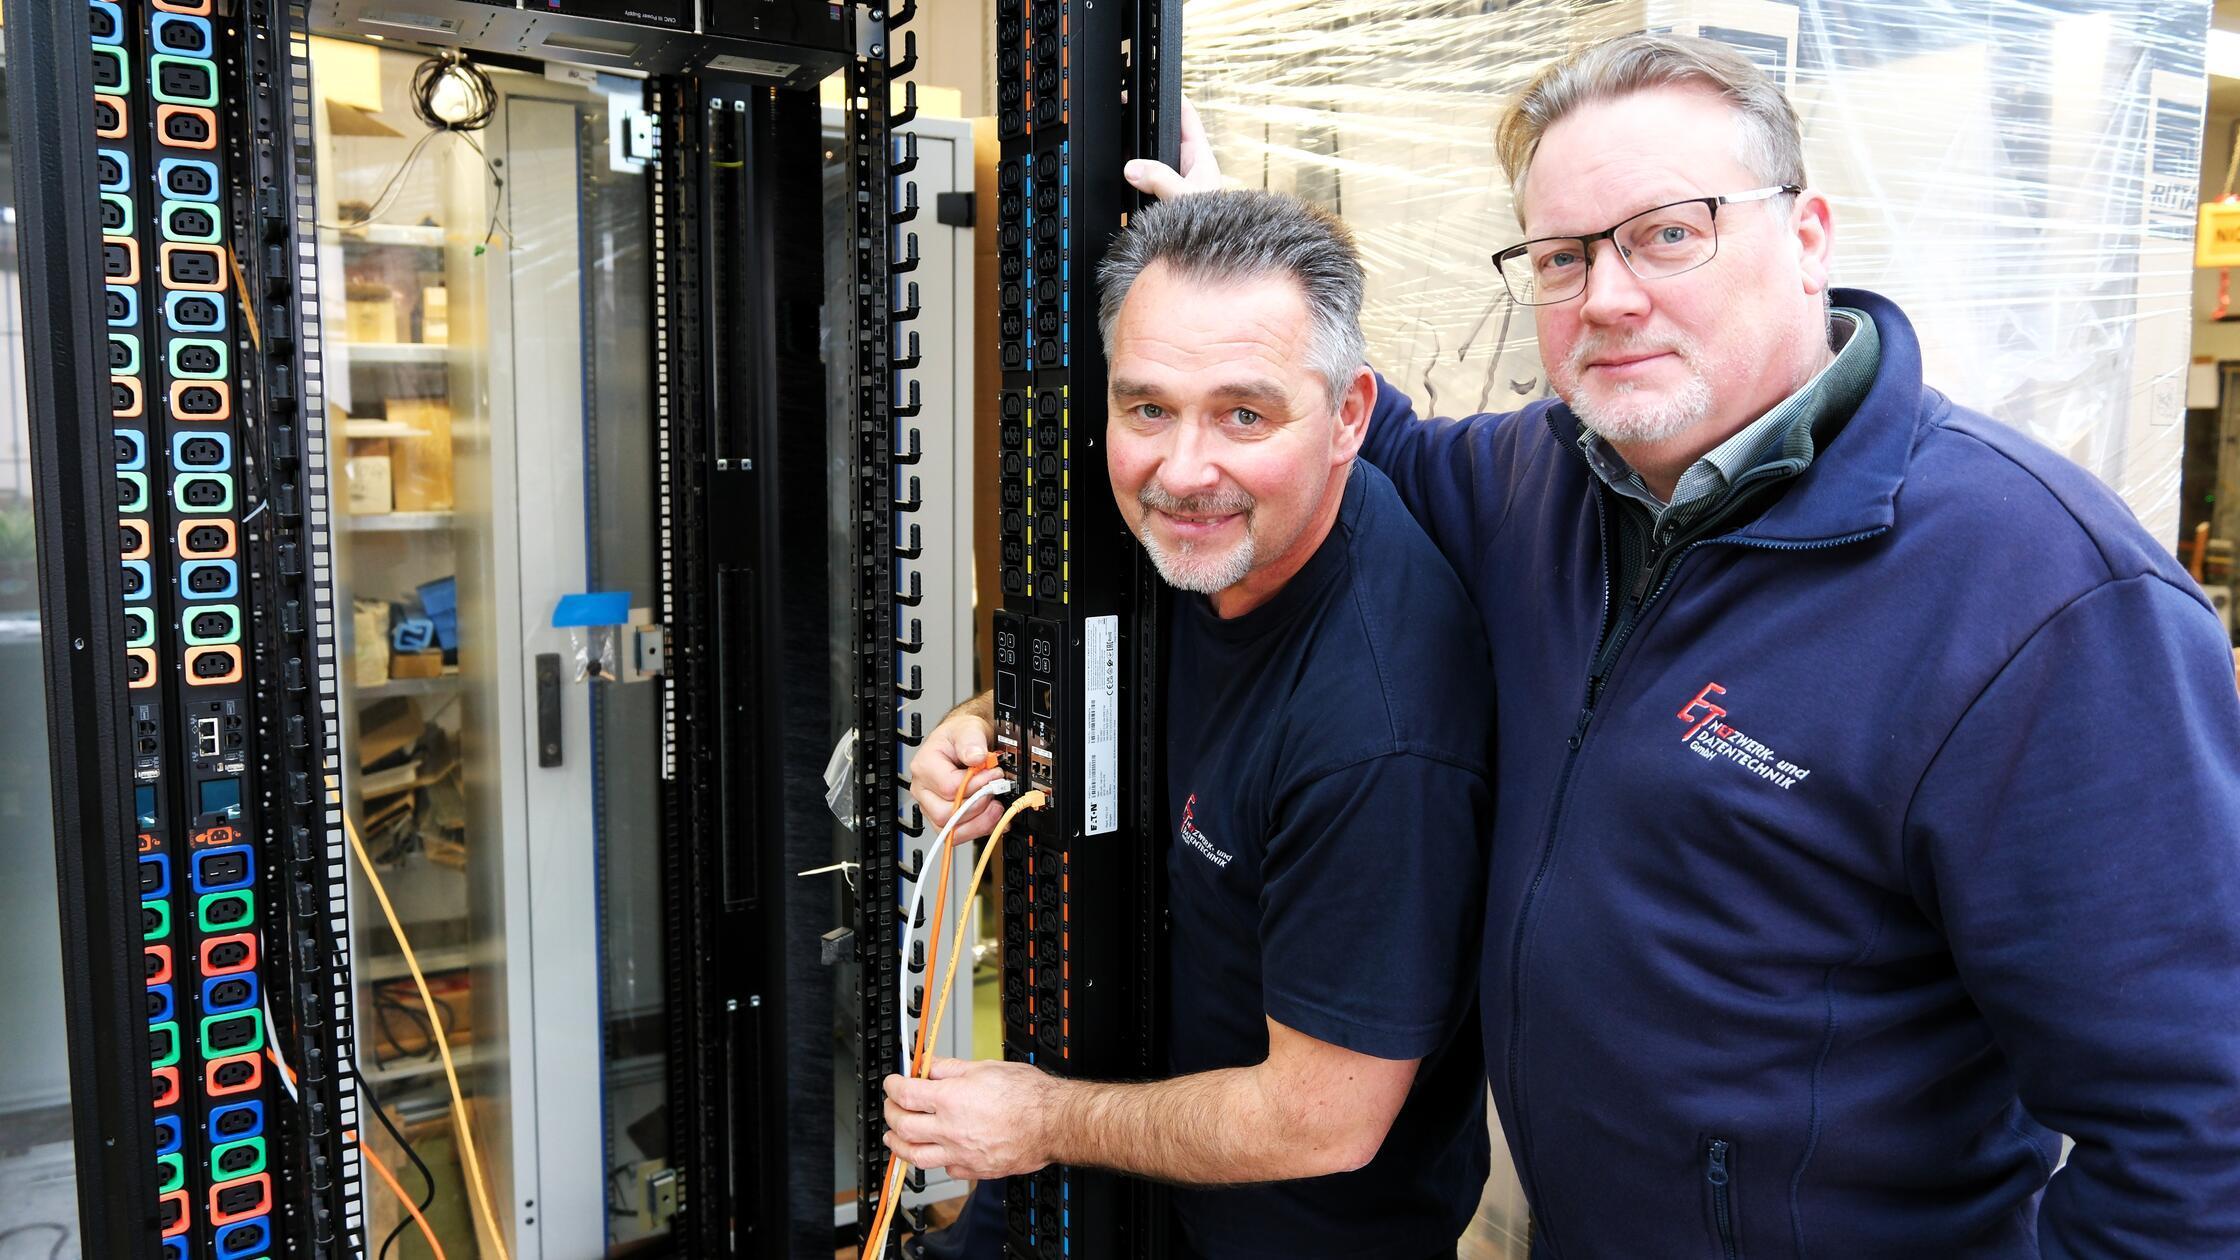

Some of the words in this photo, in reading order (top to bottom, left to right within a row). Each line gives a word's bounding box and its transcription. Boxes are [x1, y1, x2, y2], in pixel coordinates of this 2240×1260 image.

[1689, 740, 1718, 761] GmbH
[1696, 730, 1797, 790] DATENTECHNIK
[1776, 760, 1811, 780] und
[1216, 849, 1233, 862] und
